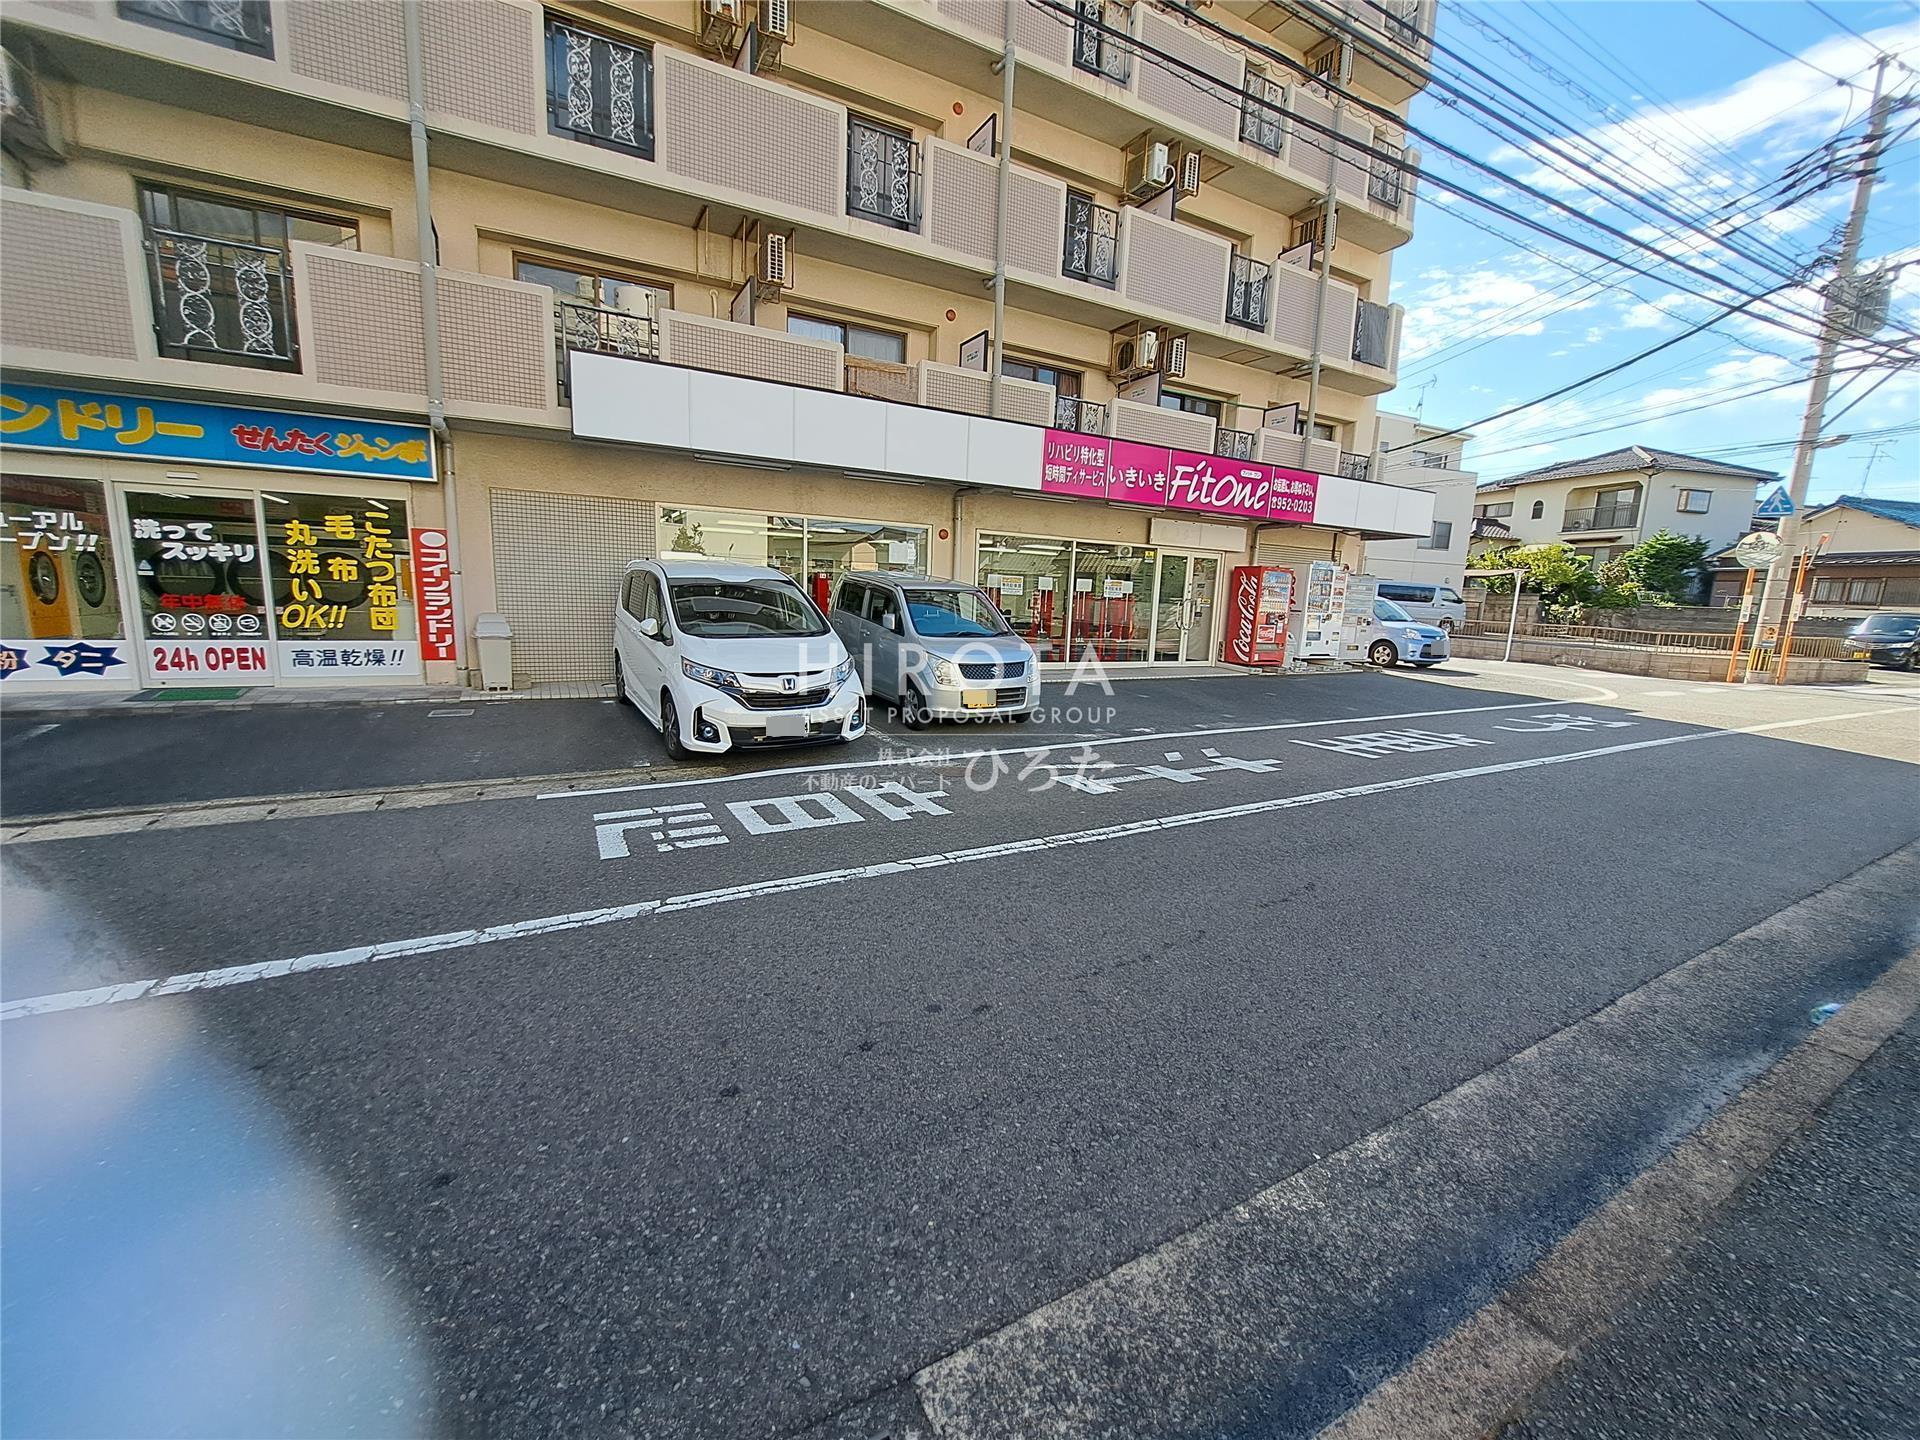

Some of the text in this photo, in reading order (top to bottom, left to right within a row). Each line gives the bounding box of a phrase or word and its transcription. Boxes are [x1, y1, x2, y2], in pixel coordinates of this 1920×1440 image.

[1047, 441, 1106, 467] リハビリ特化型
[1109, 465, 1167, 492] いきいき
[132, 518, 214, 541] 洗って
[161, 541, 257, 564] スッキリ
[324, 514, 360, 582] 毛布
[281, 519, 348, 629] 丸洗い OK!!
[364, 511, 399, 632] こたつ布団
[418, 548, 454, 659] コインランドリー
[52, 649, 105, 669] ダニ
[153, 646, 267, 671] 24h OPEN
[290, 648, 405, 668] 高温乾燥!!
